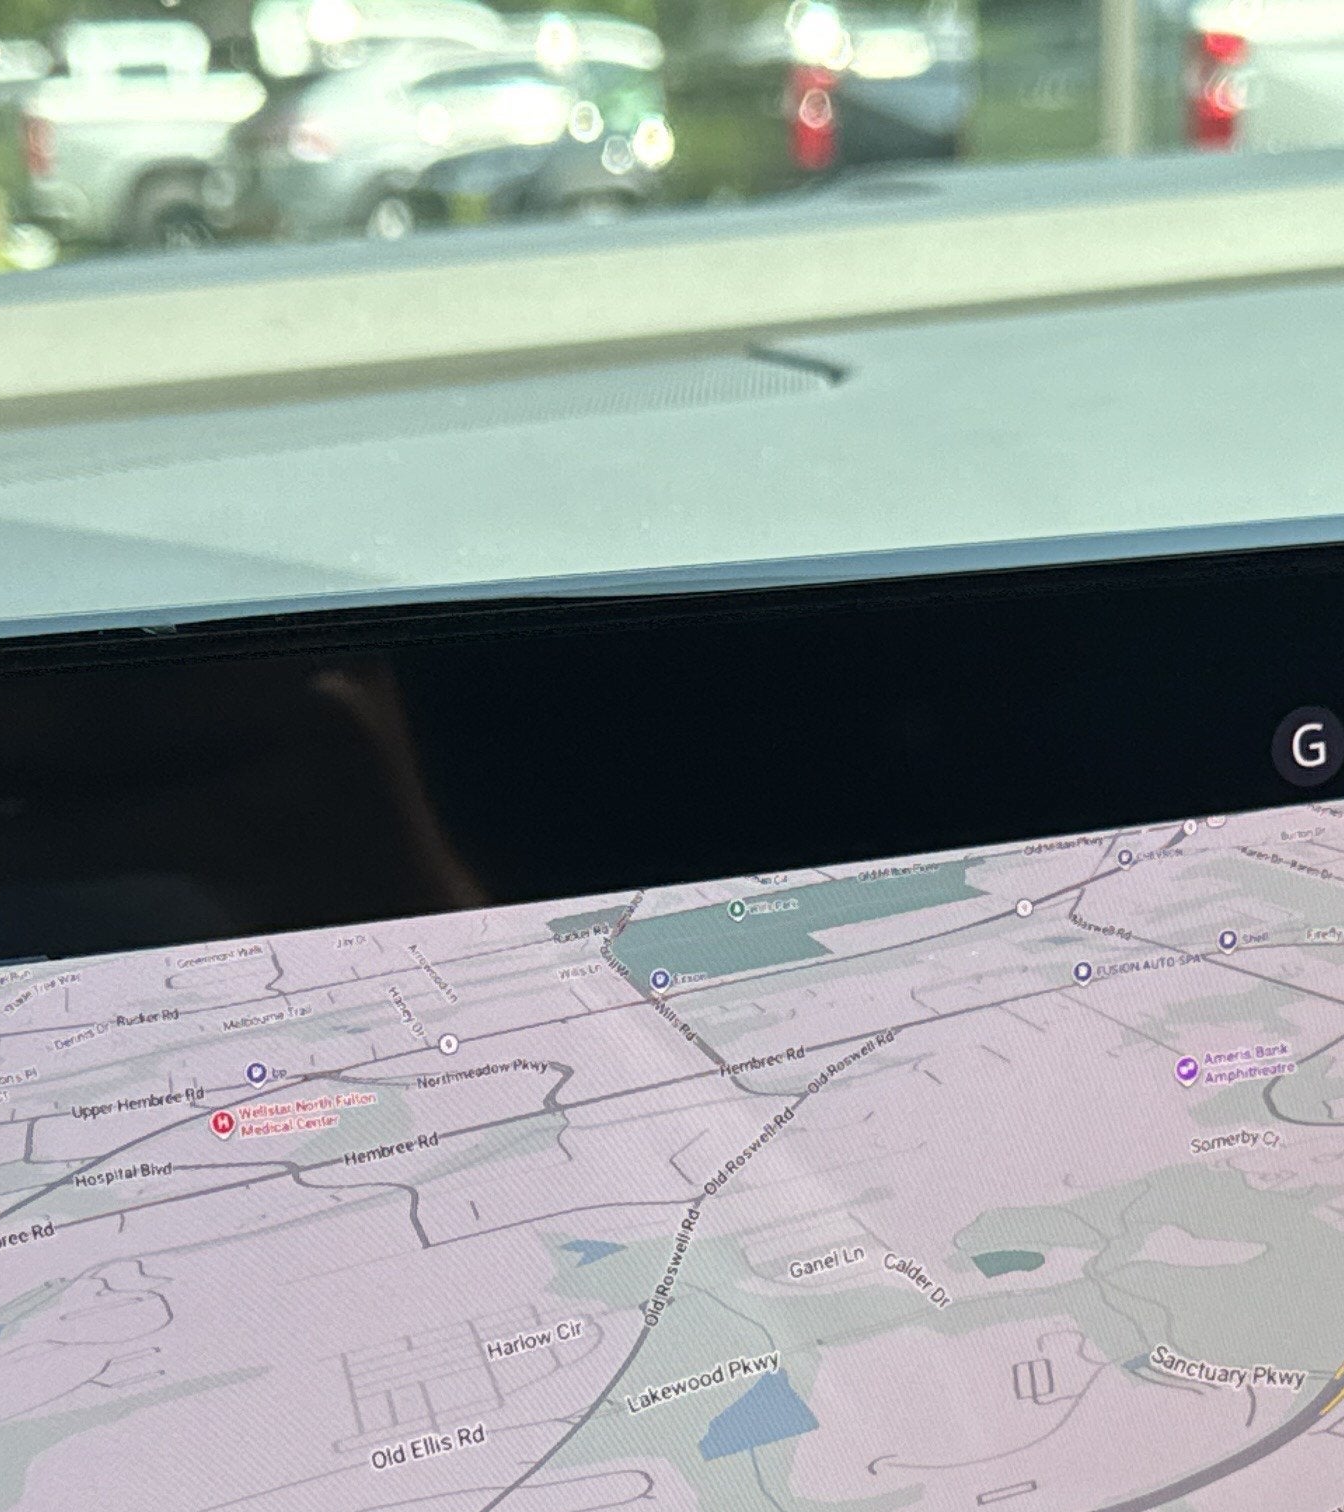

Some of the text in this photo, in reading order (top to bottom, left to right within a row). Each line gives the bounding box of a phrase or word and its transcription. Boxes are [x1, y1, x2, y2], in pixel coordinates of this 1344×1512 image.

[1290, 722, 1327, 768] G
[785, 1045, 806, 1063] Rd
[806, 1029, 895, 1095] Old Roswell Rd
[71, 1085, 205, 1121] Upper Hembree Rd
[344, 1133, 440, 1166] Hembree Rd
[703, 1106, 796, 1197] Old Roswell Rd
[1190, 1130, 1260, 1155] Somerby
[74, 1161, 174, 1188] Hospital Blvd
[30, 1221, 57, 1241] Rd
[644, 1207, 700, 1328] Old Roswell Rd
[842, 1246, 865, 1264] Ln
[883, 1252, 952, 1310] Calder Dr
[486, 1320, 584, 1361] Harlow Cir
[627, 1350, 780, 1414] Lakewood Pkwy
[1149, 1344, 1306, 1391] Sanctuary Pkwy
[371, 1425, 486, 1472] Old Ellis Rd
